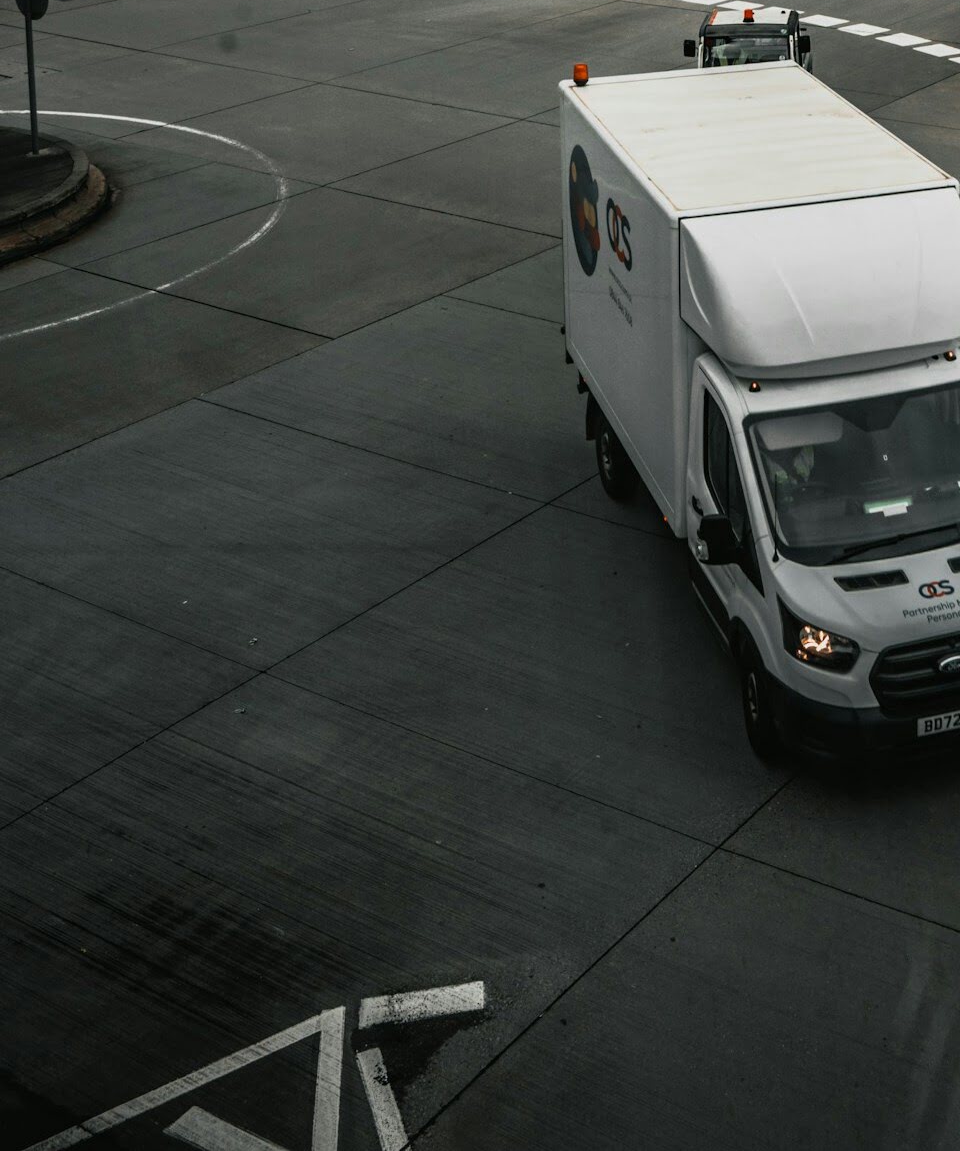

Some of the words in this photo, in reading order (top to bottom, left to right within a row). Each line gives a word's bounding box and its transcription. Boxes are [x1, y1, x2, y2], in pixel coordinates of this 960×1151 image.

[606, 197, 633, 272] OCS
[918, 579, 955, 599] OCS
[902, 600, 956, 619] Partnership
